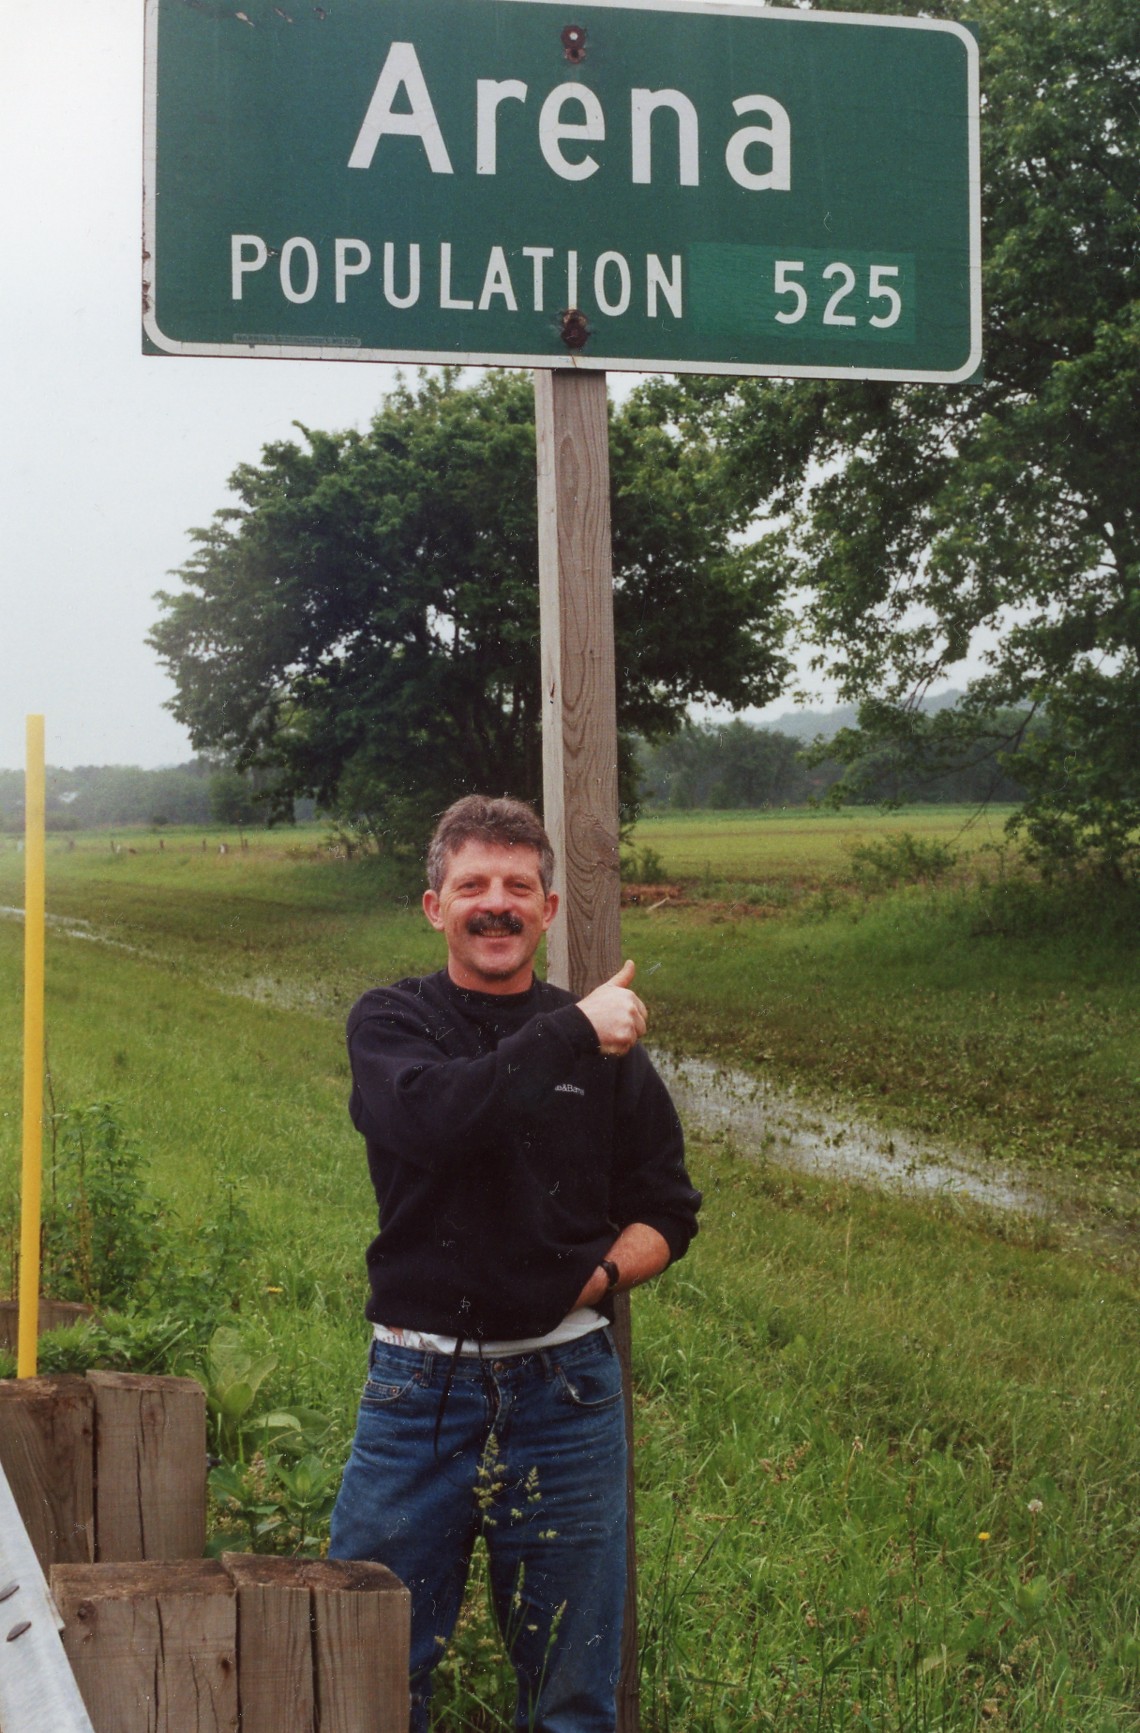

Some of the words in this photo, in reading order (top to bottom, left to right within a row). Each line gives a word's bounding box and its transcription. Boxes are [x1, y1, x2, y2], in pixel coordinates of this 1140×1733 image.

[347, 41, 794, 192] Arena
[230, 233, 683, 319] POPULATION
[773, 260, 903, 330] 525
